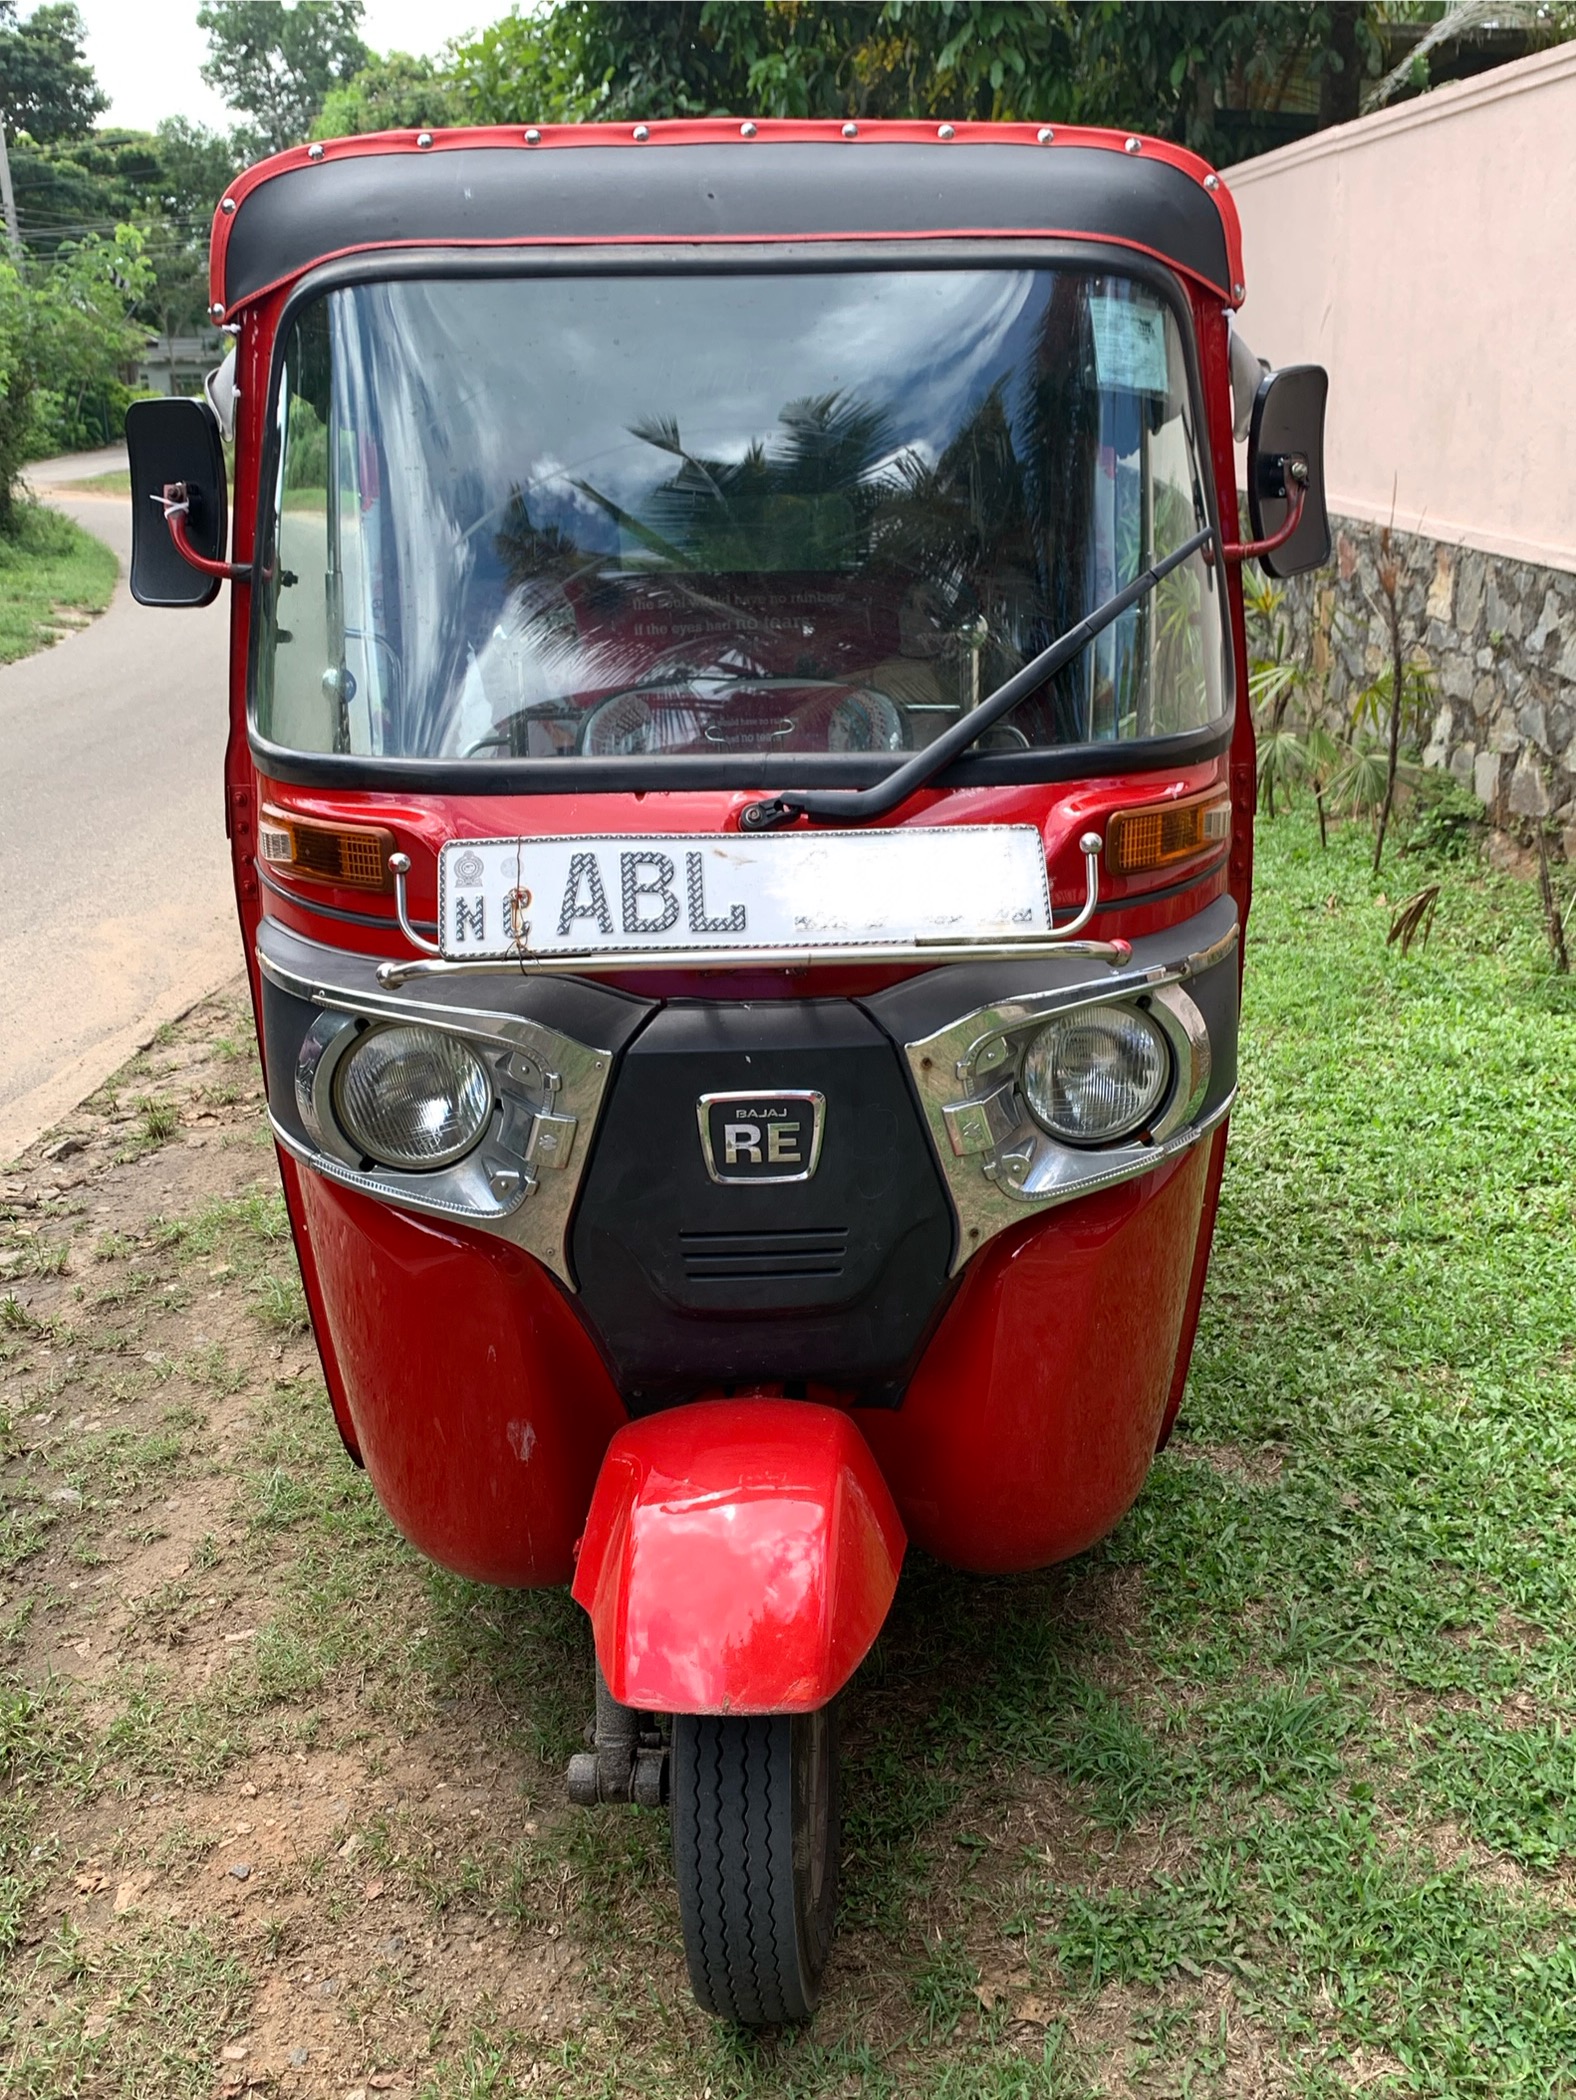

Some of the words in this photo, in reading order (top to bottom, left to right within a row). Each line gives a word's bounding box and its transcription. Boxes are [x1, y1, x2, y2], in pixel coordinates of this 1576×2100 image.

[646, 623, 668, 635] the
[671, 623, 702, 637] eyes
[705, 619, 731, 632] had
[736, 617, 758, 630] no
[556, 851, 747, 936] ABL
[736, 1108, 787, 1119] BAJAJ
[724, 1122, 801, 1164] RE
